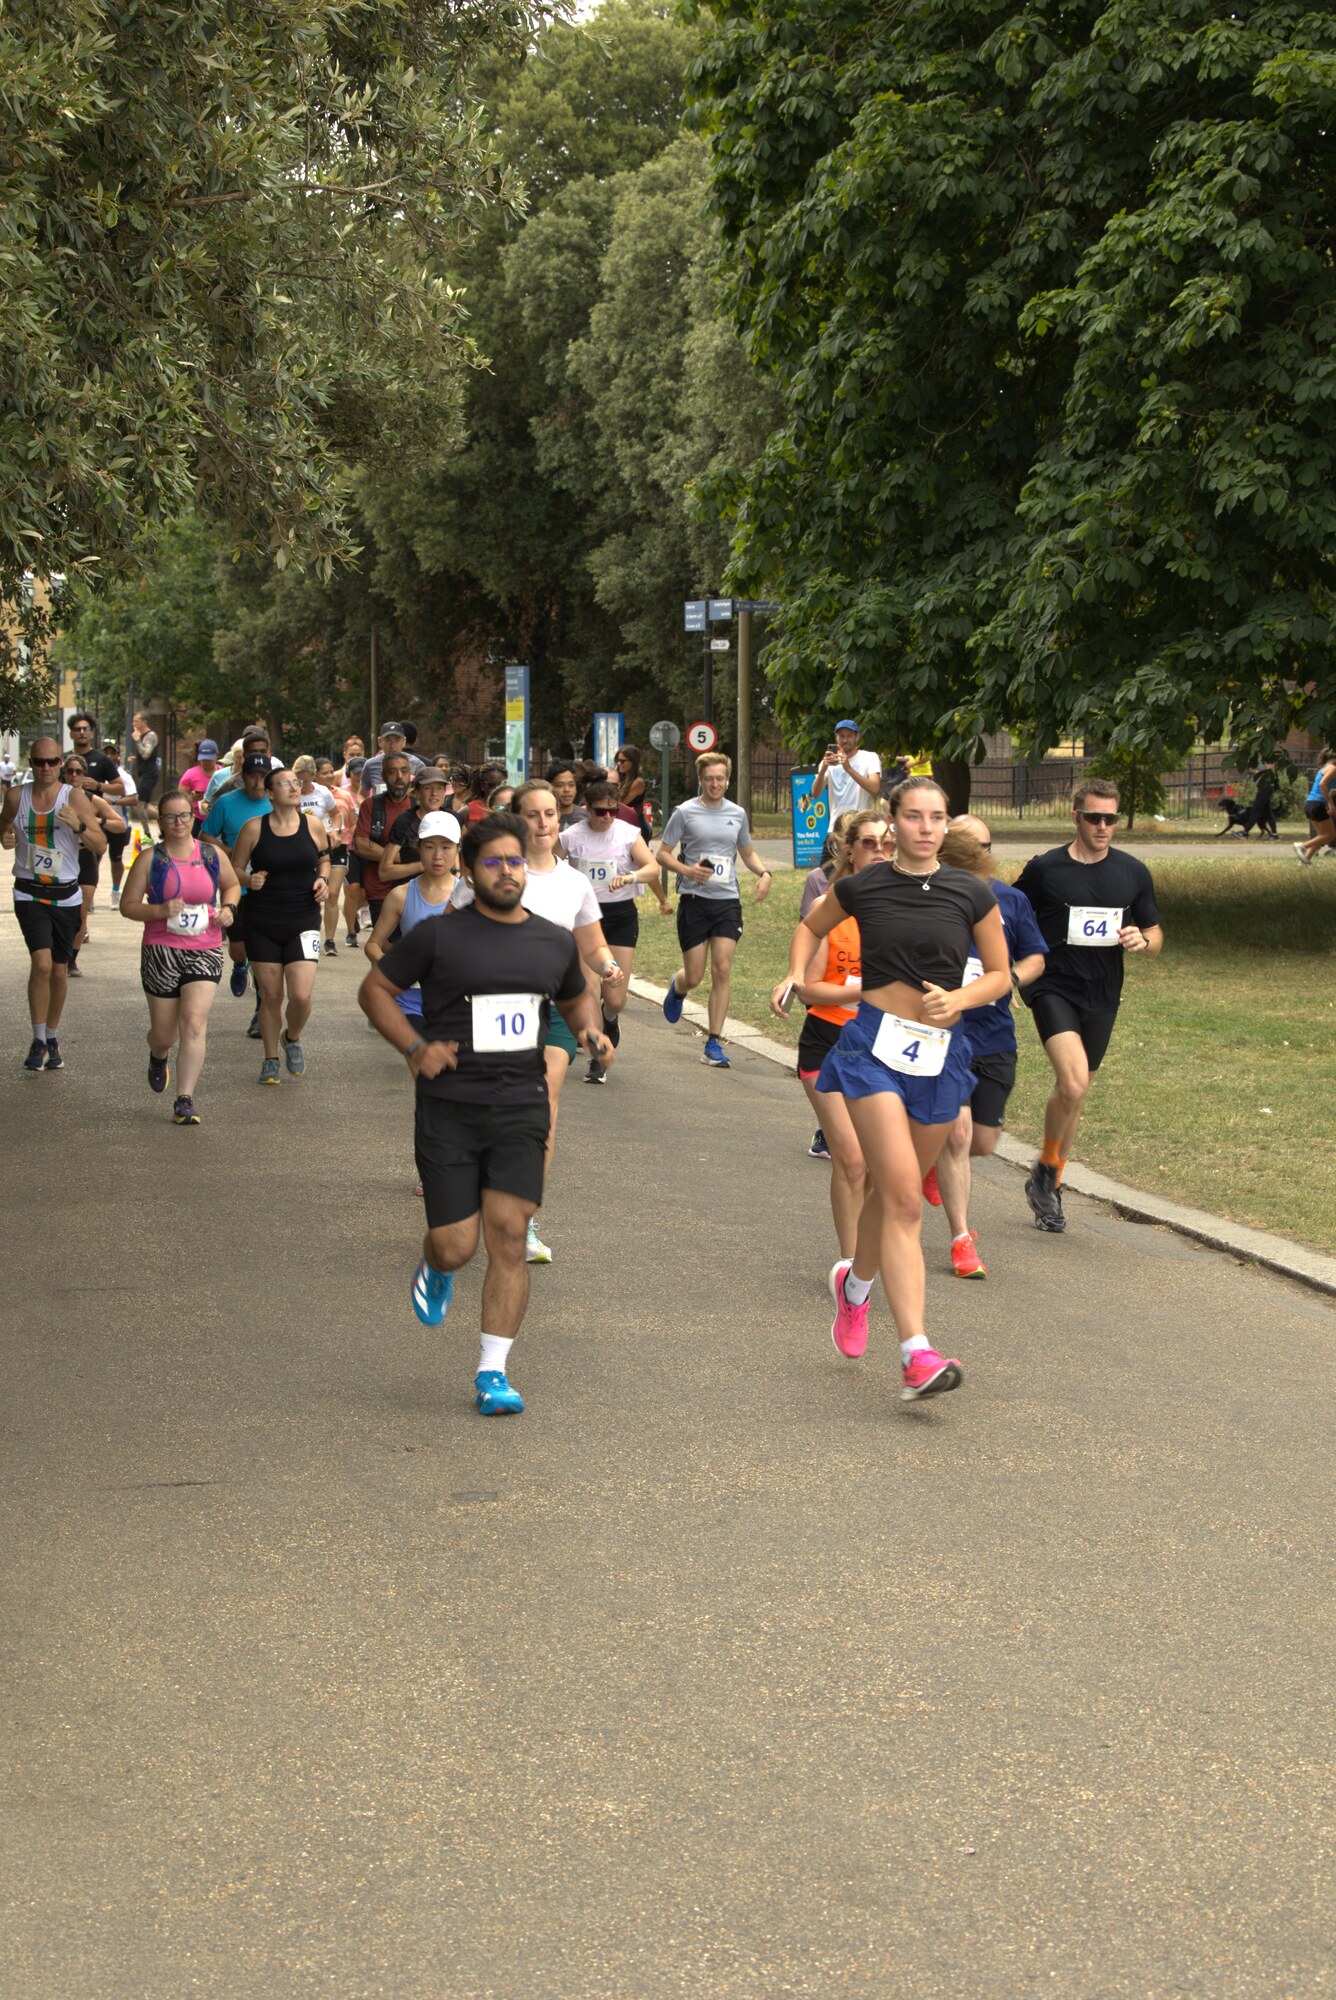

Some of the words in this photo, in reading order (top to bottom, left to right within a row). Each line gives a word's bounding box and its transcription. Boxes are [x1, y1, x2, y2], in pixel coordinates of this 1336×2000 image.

[697, 731, 707, 744] 5
[34, 854, 53, 869] 79
[589, 868, 606, 880] 19
[179, 913, 199, 928] 37
[1083, 920, 1108, 937] 64
[495, 1012, 526, 1036] 10
[902, 1040, 920, 1062] 4
